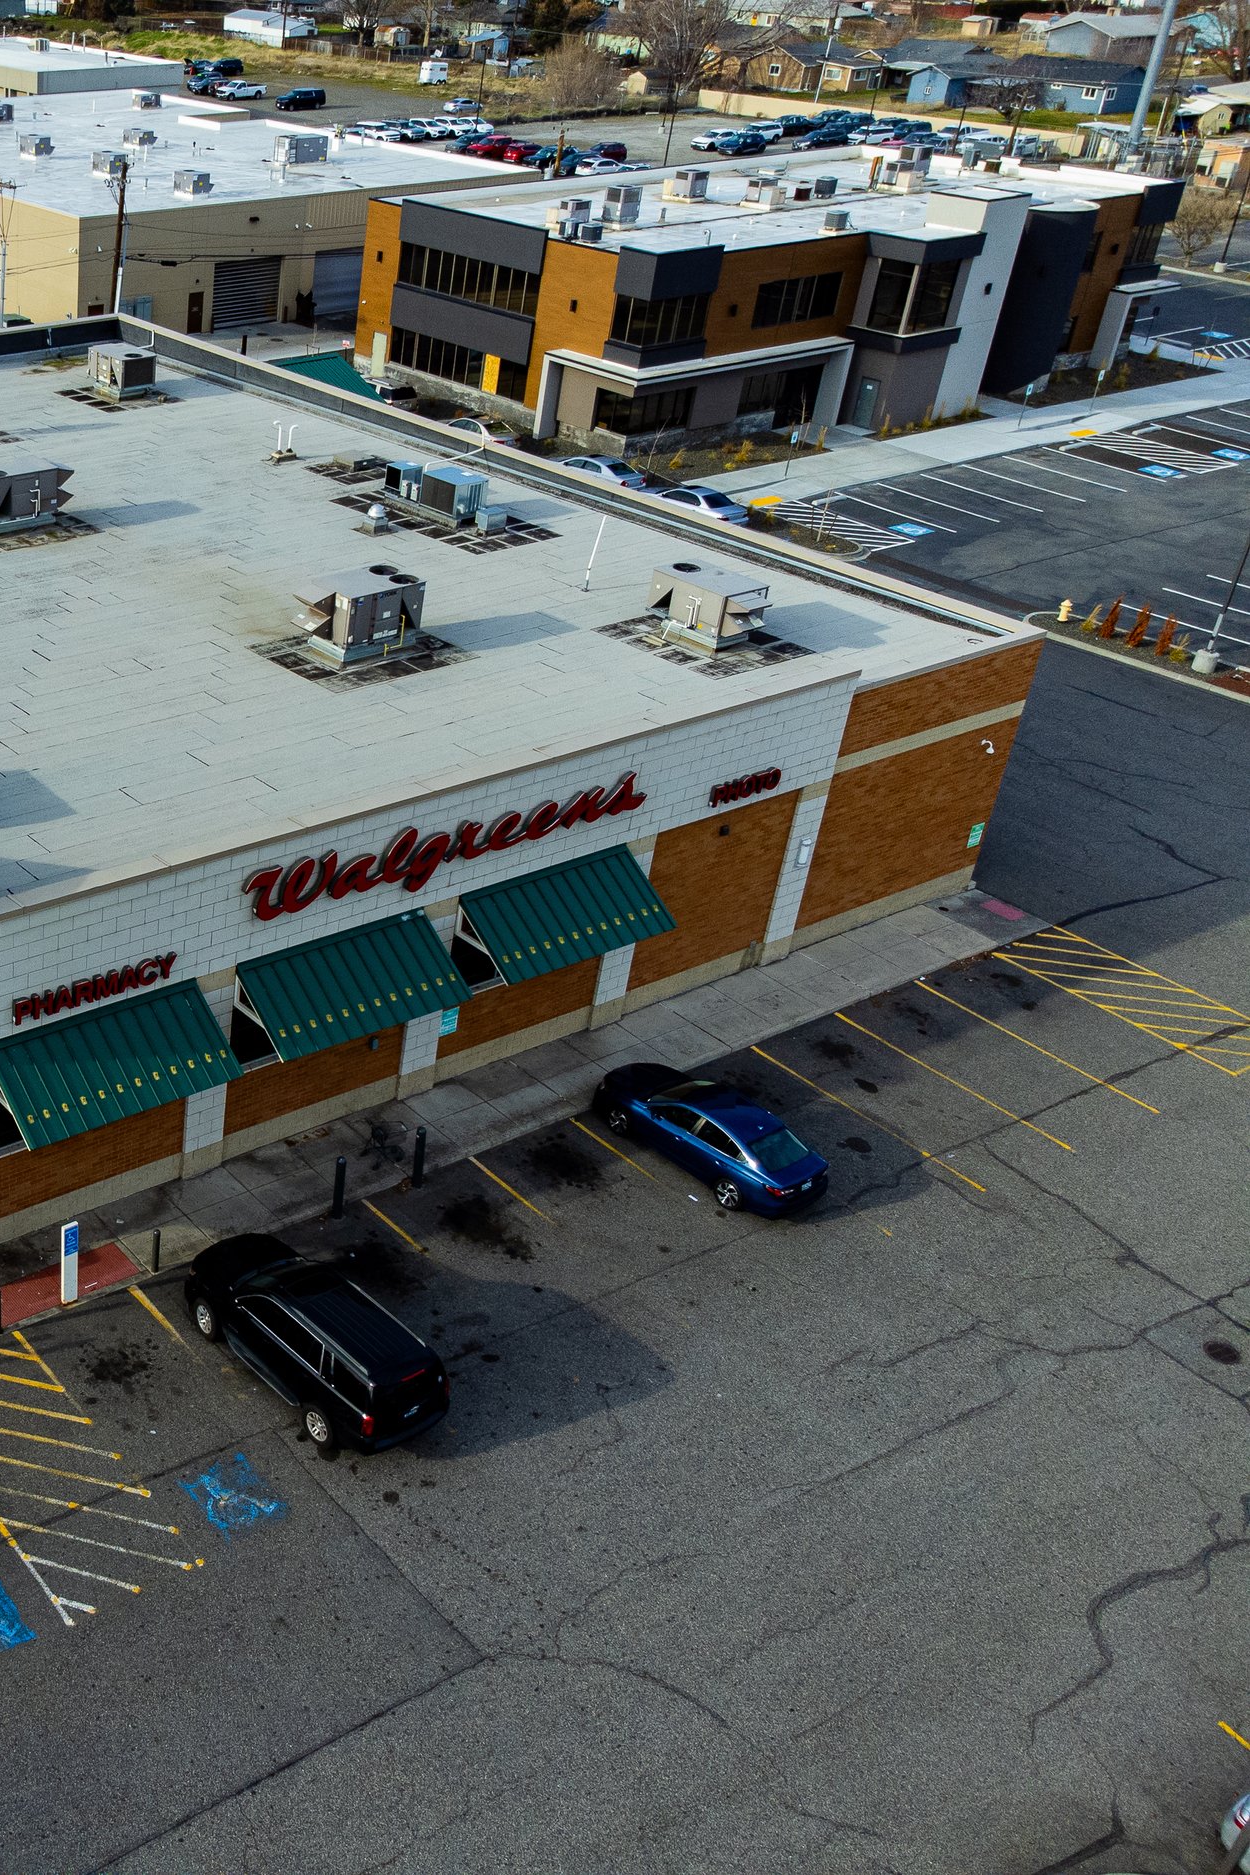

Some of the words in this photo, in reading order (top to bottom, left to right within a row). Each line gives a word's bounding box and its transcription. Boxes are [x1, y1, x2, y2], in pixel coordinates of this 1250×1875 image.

[708, 767, 781, 808] PHOTO
[241, 770, 648, 921] Walgreens
[12, 951, 177, 1025] PHARMACY
